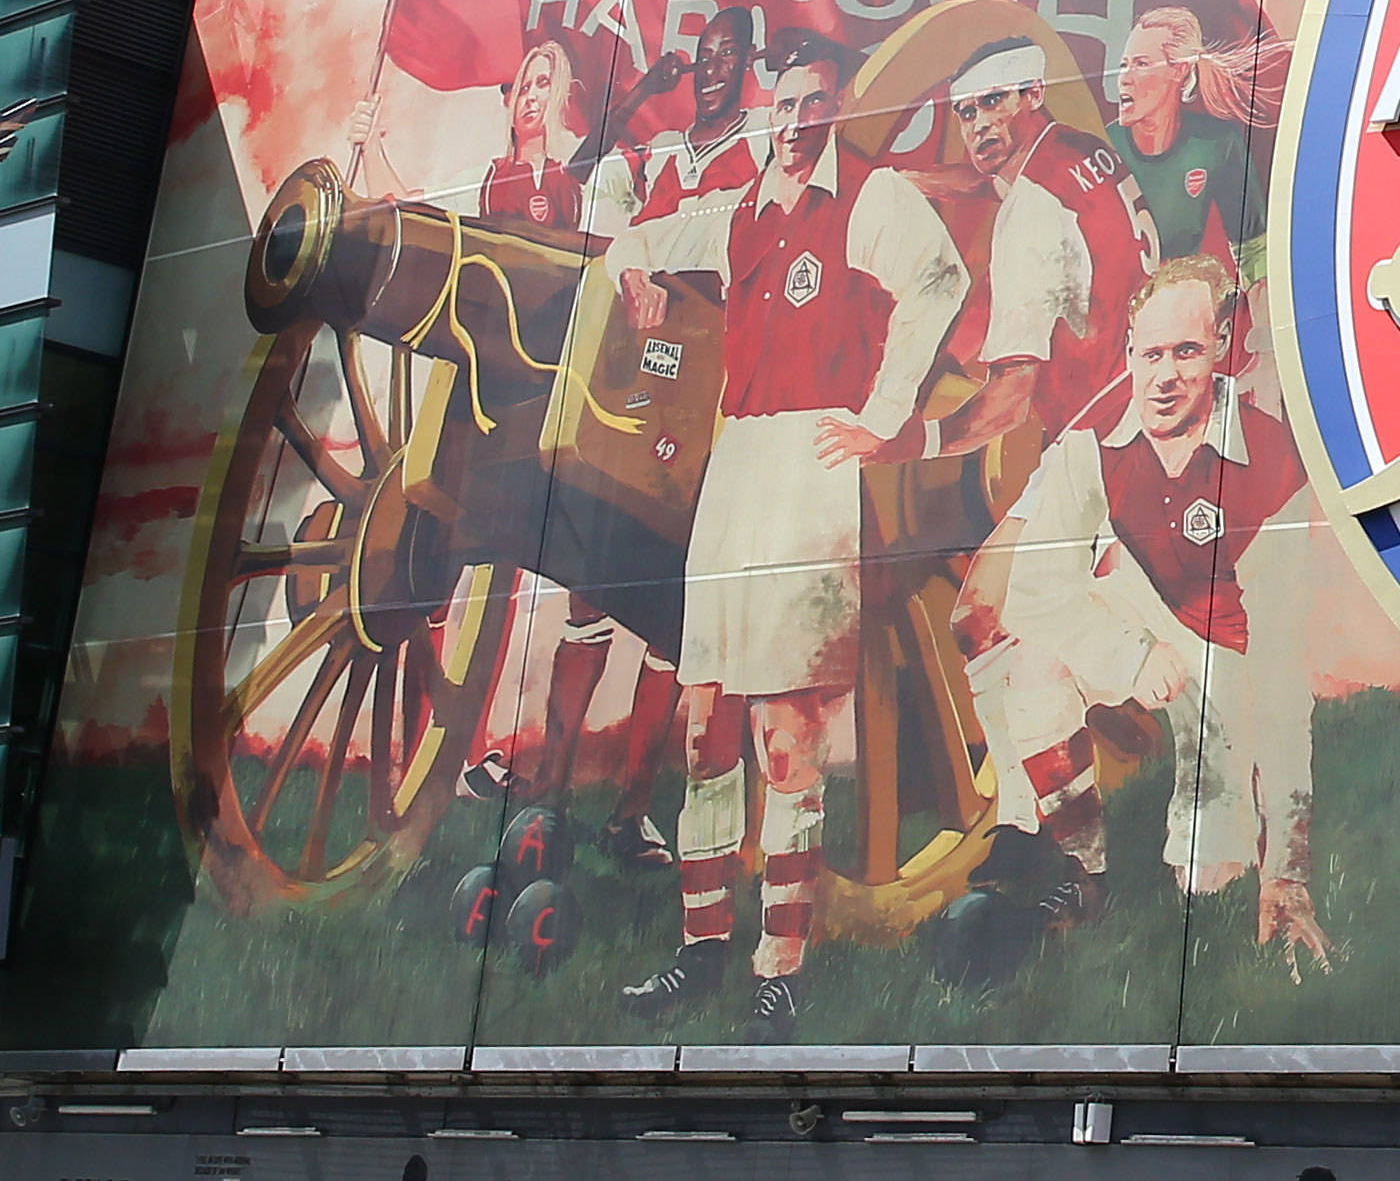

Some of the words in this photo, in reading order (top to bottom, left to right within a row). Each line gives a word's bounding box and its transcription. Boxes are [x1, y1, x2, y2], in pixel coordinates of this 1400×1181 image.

[1068, 148, 1122, 193] KEO
[642, 357, 677, 376] MAGIC
[655, 436, 676, 461] 49
[516, 814, 545, 871] A
[465, 887, 498, 935] F
